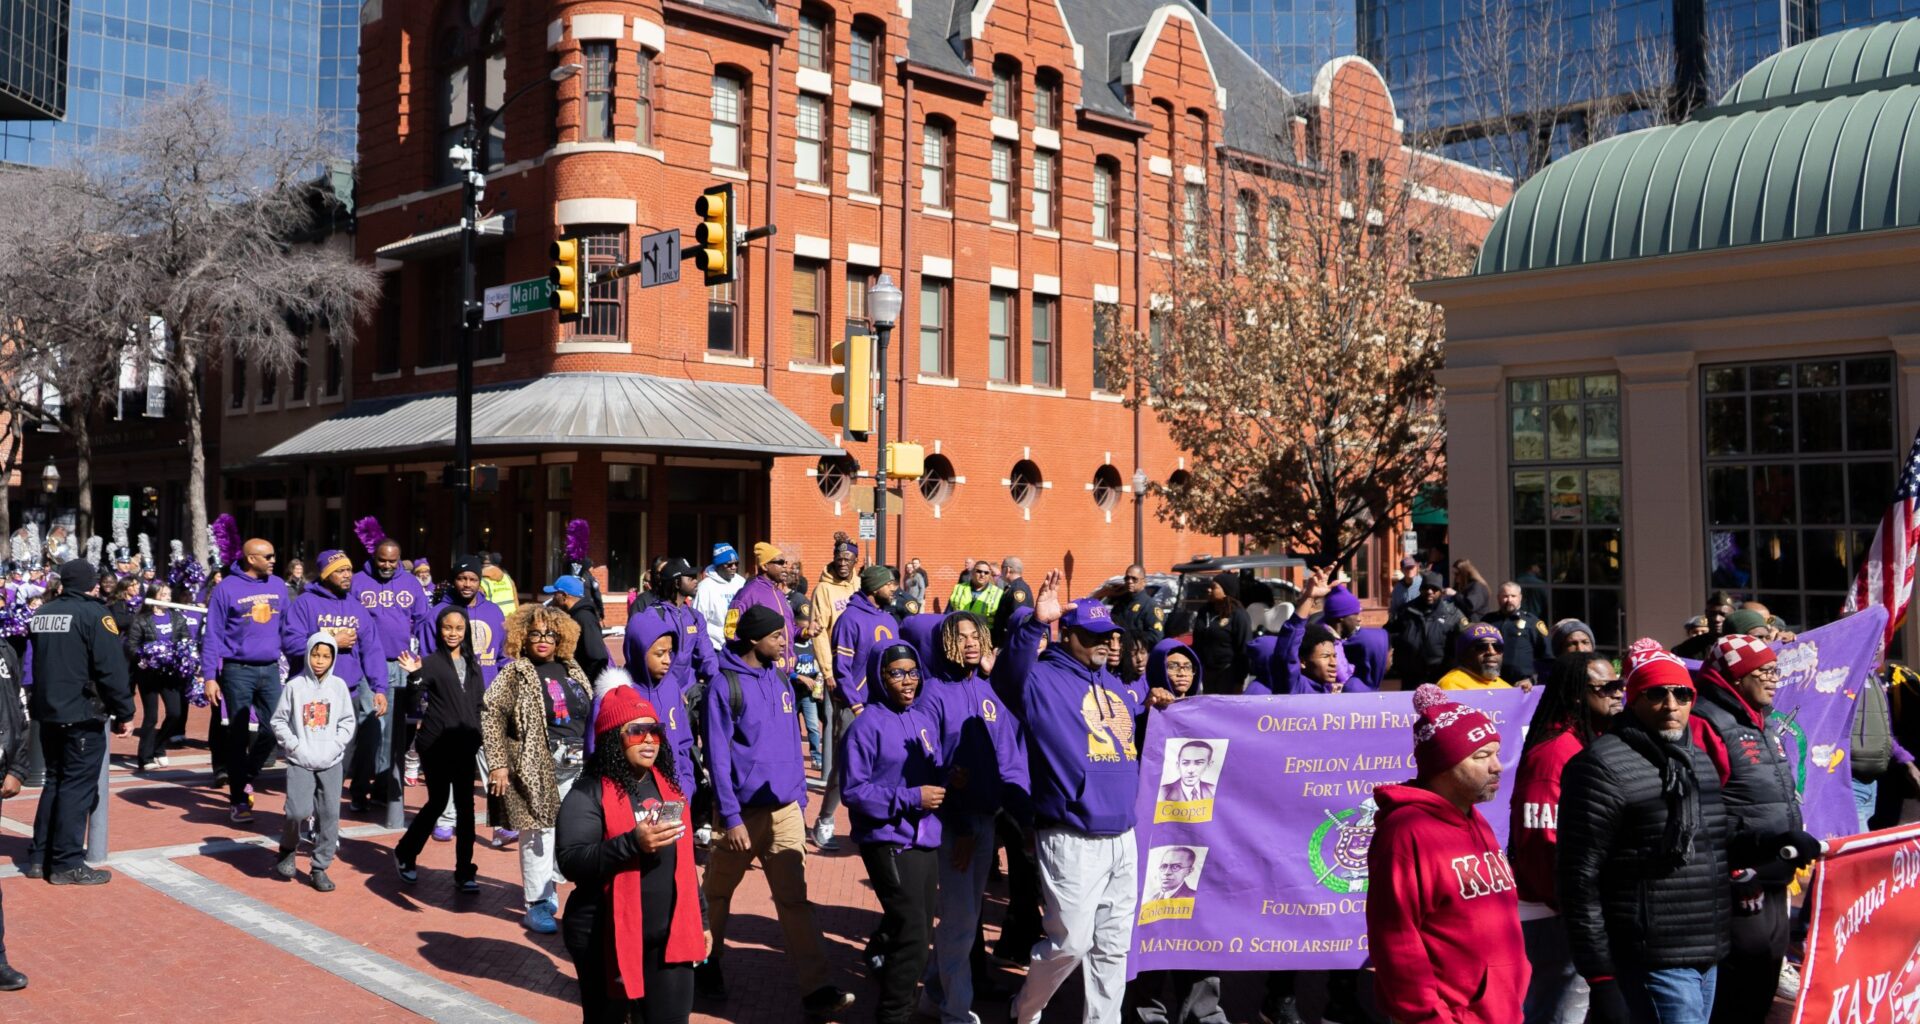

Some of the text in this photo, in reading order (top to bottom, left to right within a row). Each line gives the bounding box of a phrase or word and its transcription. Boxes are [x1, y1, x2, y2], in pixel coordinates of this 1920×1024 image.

[662, 271, 678, 281] ONLY
[512, 283, 539, 304] Main
[33, 616, 68, 631] POLICE
[1257, 714, 1317, 732] OMEGA
[1323, 713, 1346, 730] PSI
[1350, 712, 1376, 729] PHI
[1381, 711, 1420, 728] FRAT
[1284, 756, 1349, 773] EPSILON
[1352, 754, 1402, 771] ALPHA
[1302, 781, 1343, 797] FORT
[1161, 804, 1207, 821] Cooper
[1524, 802, 1558, 829] KA
[1261, 898, 1368, 915] FOUNDED OCT
[1833, 839, 1920, 964] Kappa Alp
[1141, 905, 1190, 921] Coleman
[1139, 938, 1223, 954] MANHOOD
[1228, 937, 1243, 953] Ω
[1249, 938, 1353, 953] SCHOLARSHIP
